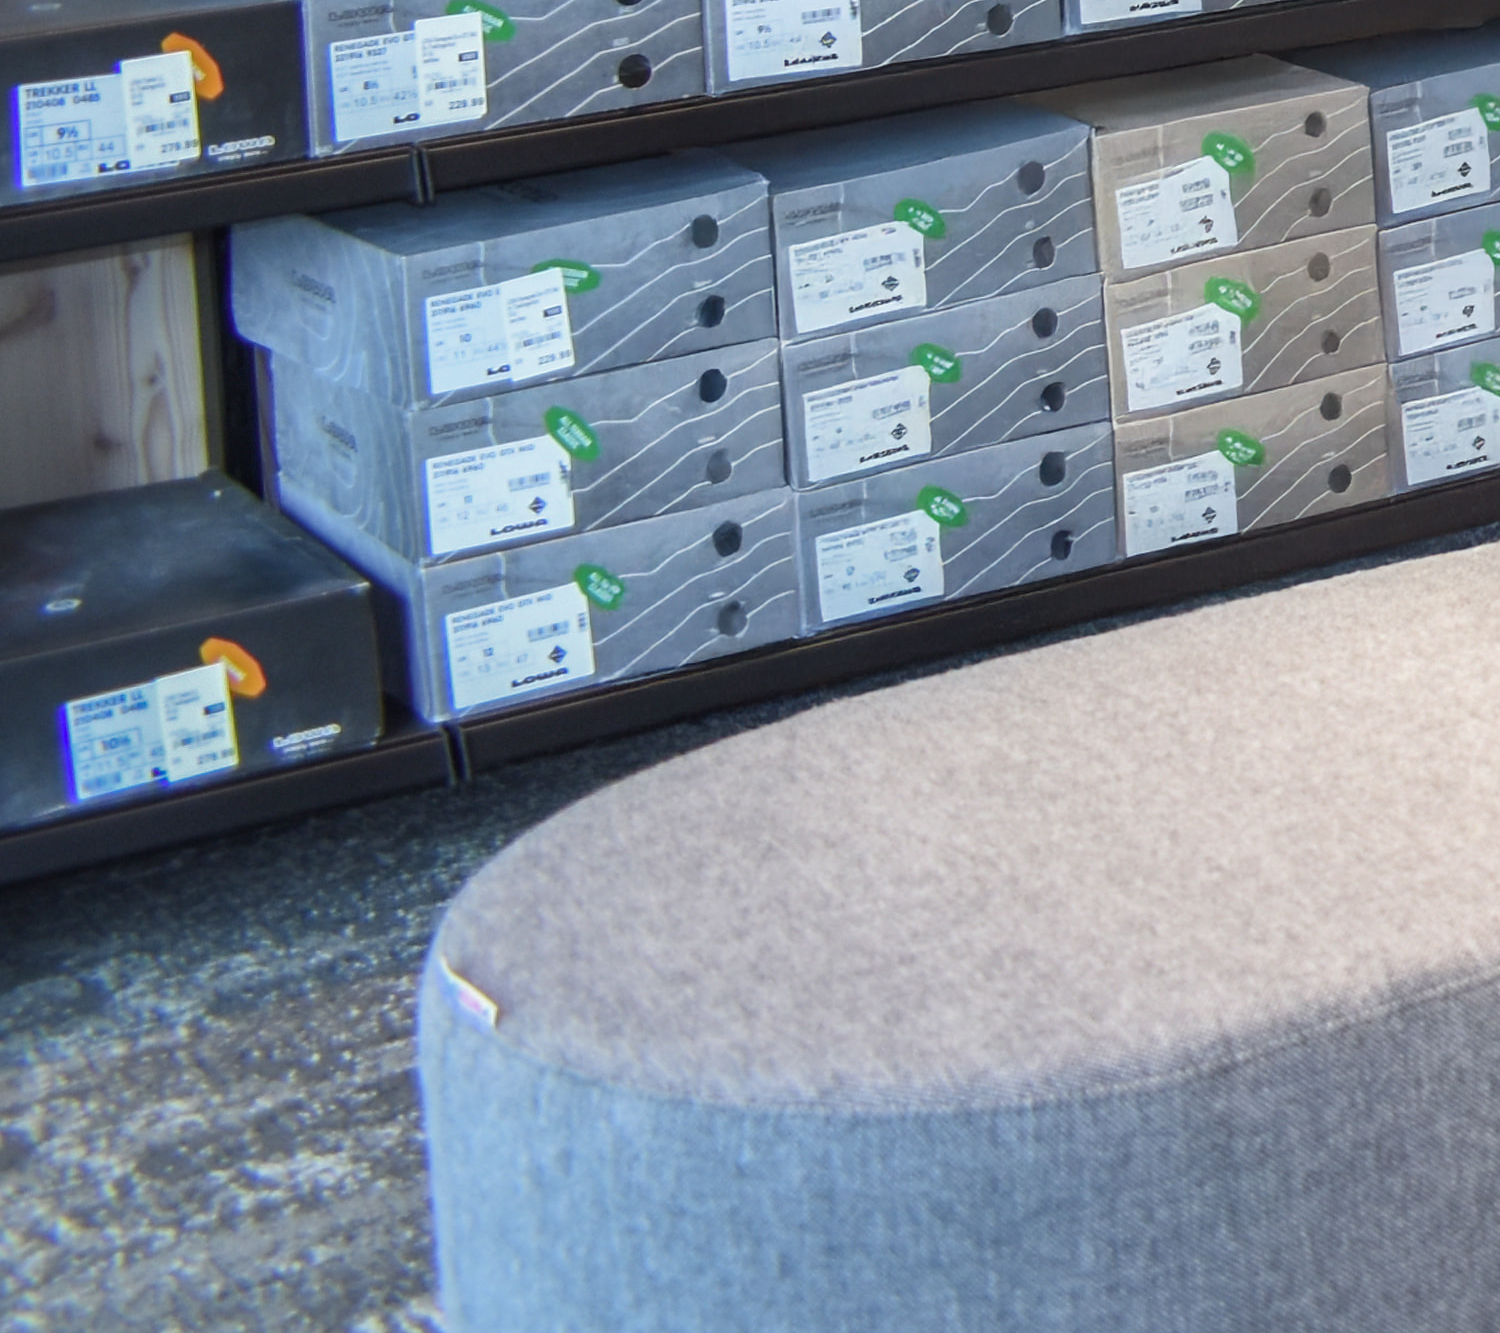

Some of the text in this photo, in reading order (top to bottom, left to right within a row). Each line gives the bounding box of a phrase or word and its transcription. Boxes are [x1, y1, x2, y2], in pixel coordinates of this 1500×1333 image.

[334, 40, 380, 54] RENEGADE
[25, 83, 80, 100] TREKKER
[393, 111, 420, 125] LO
[207, 134, 276, 156] LOWA
[97, 159, 130, 174] LO
[490, 518, 549, 537] LOWA
[511, 667, 569, 688] LOWA
